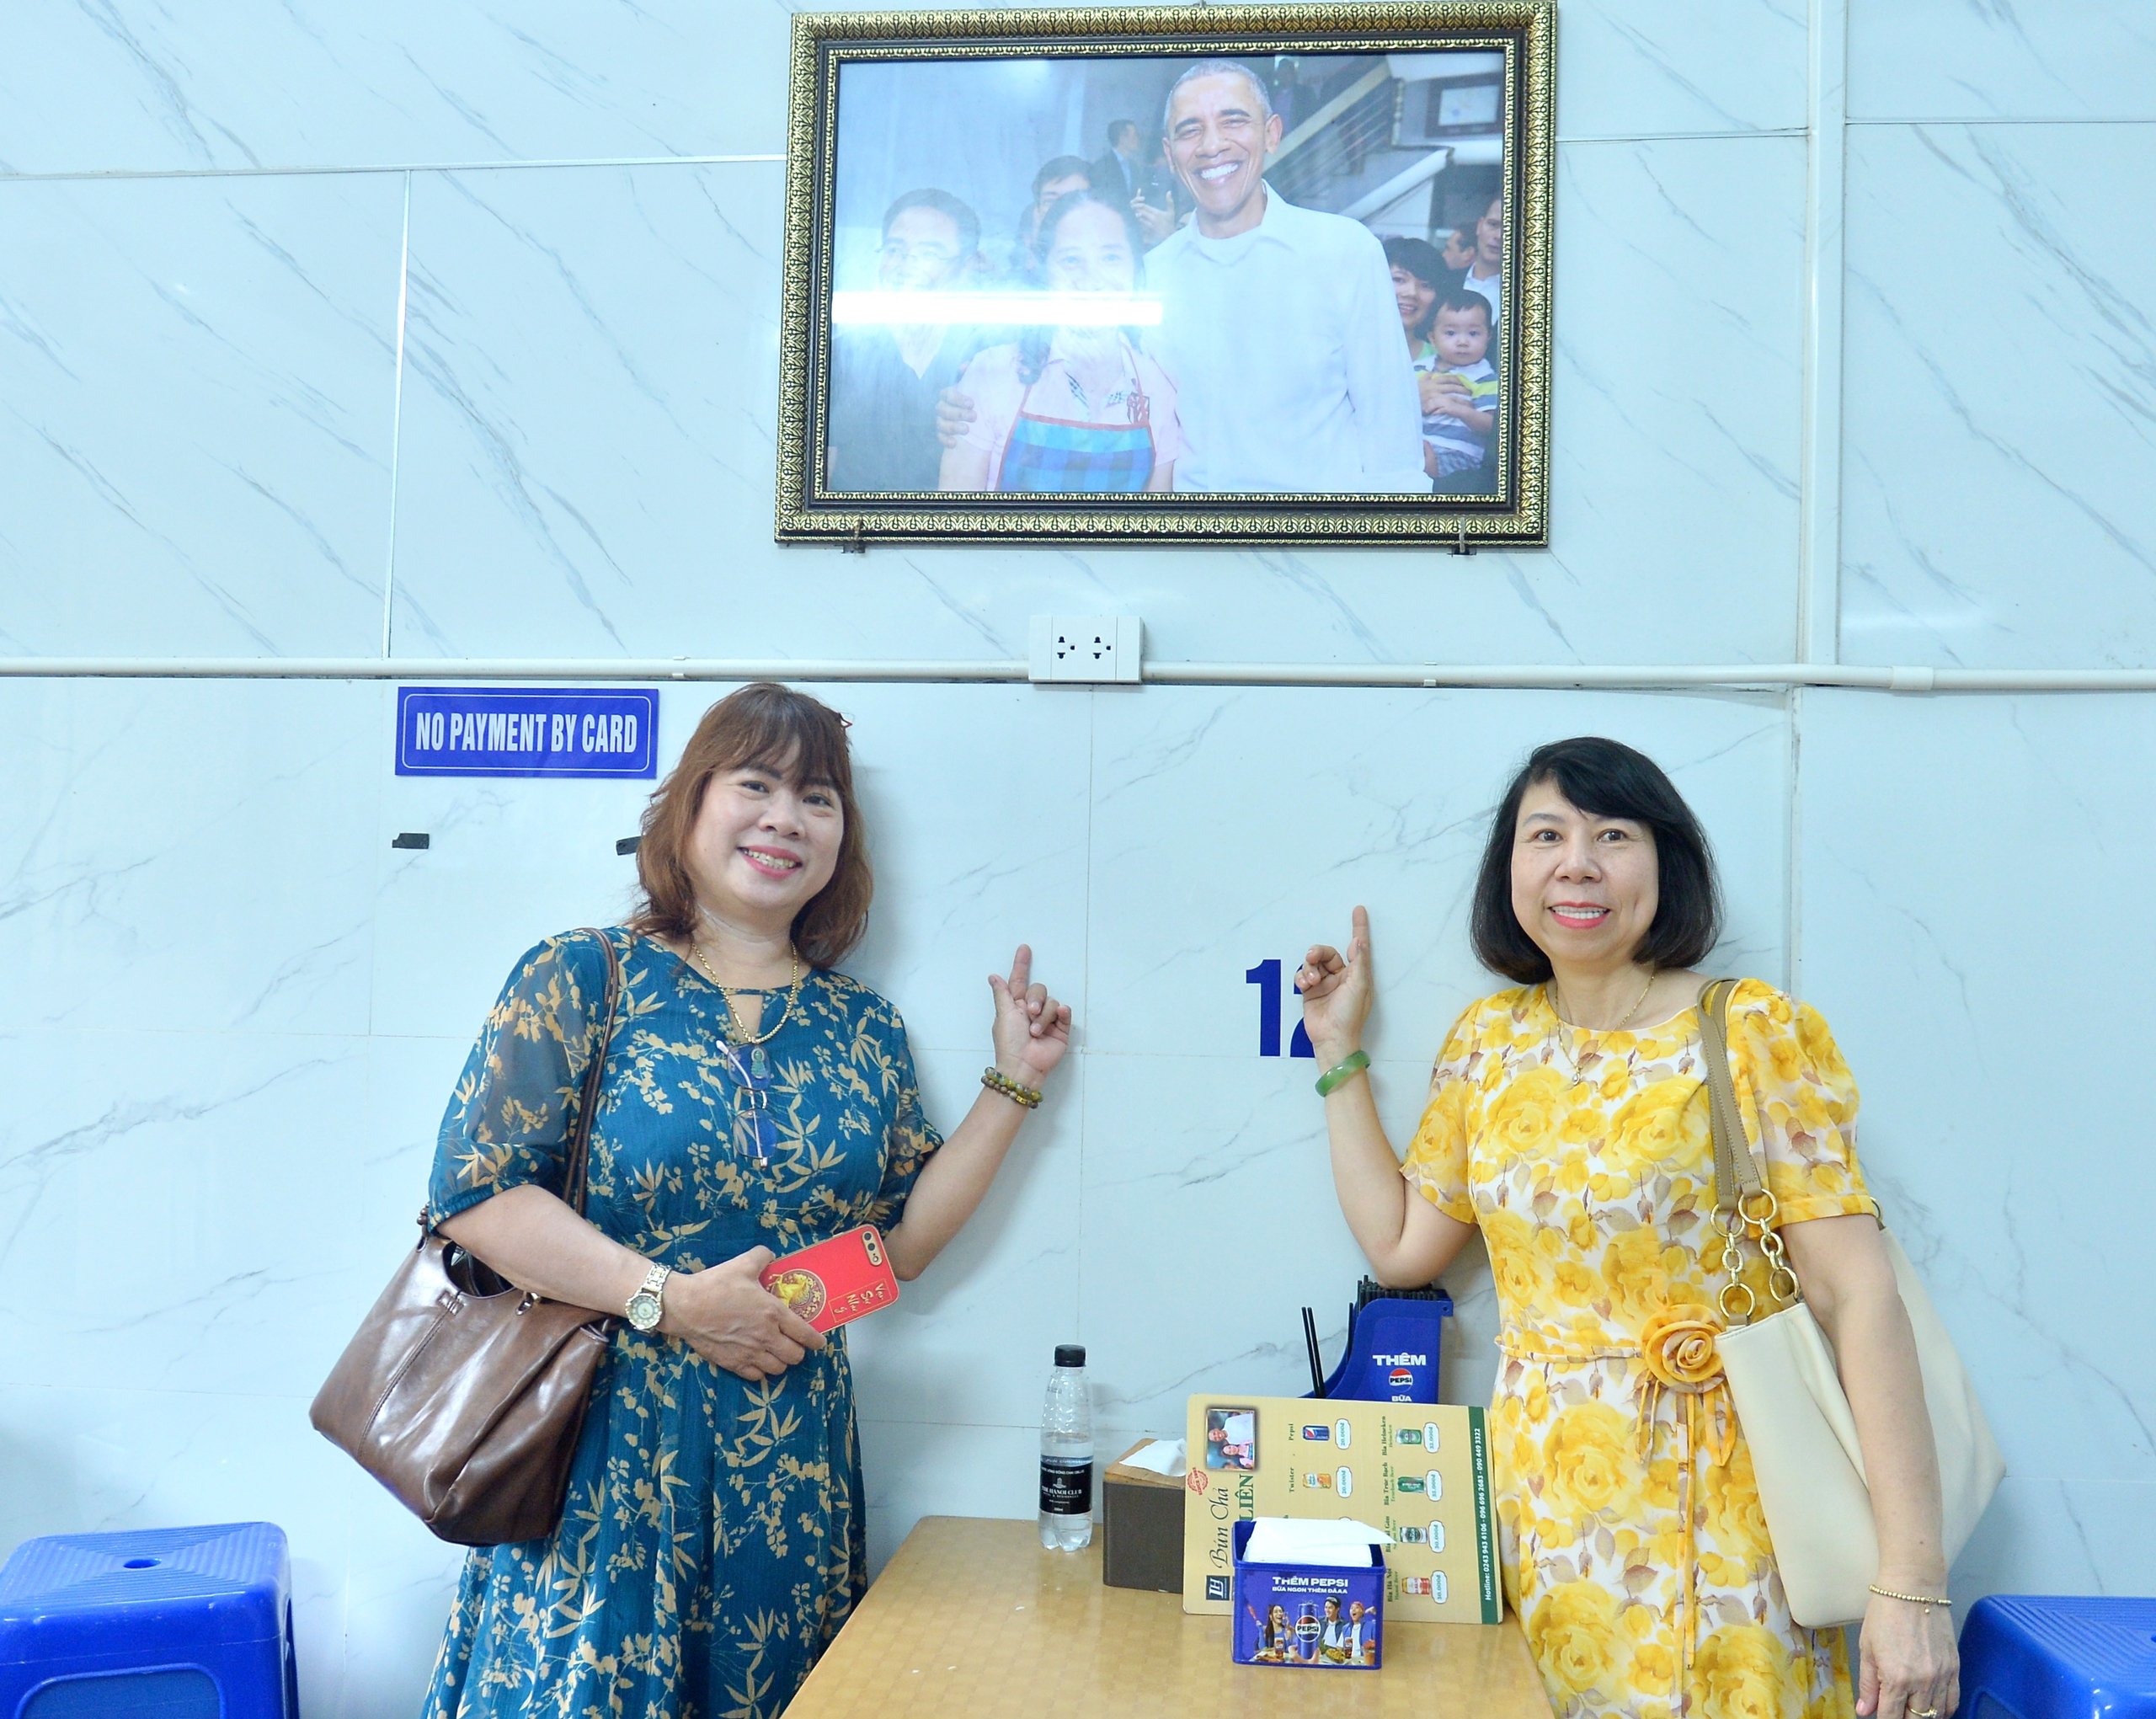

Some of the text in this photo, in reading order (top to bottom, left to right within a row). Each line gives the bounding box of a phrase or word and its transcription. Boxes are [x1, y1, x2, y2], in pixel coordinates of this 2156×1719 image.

[416, 712, 638, 753] NO PAYMENT BY CARD
[1372, 1352, 1427, 1366] THÊM
[1474, 1428, 1482, 1444] 3322
[1476, 1475, 1485, 1492] 2683
[1235, 1473, 1254, 1521] LIÊN
[1209, 1487, 1229, 1569] Bún Chả
[1272, 1575, 1349, 1588] THÊM PEPSI
